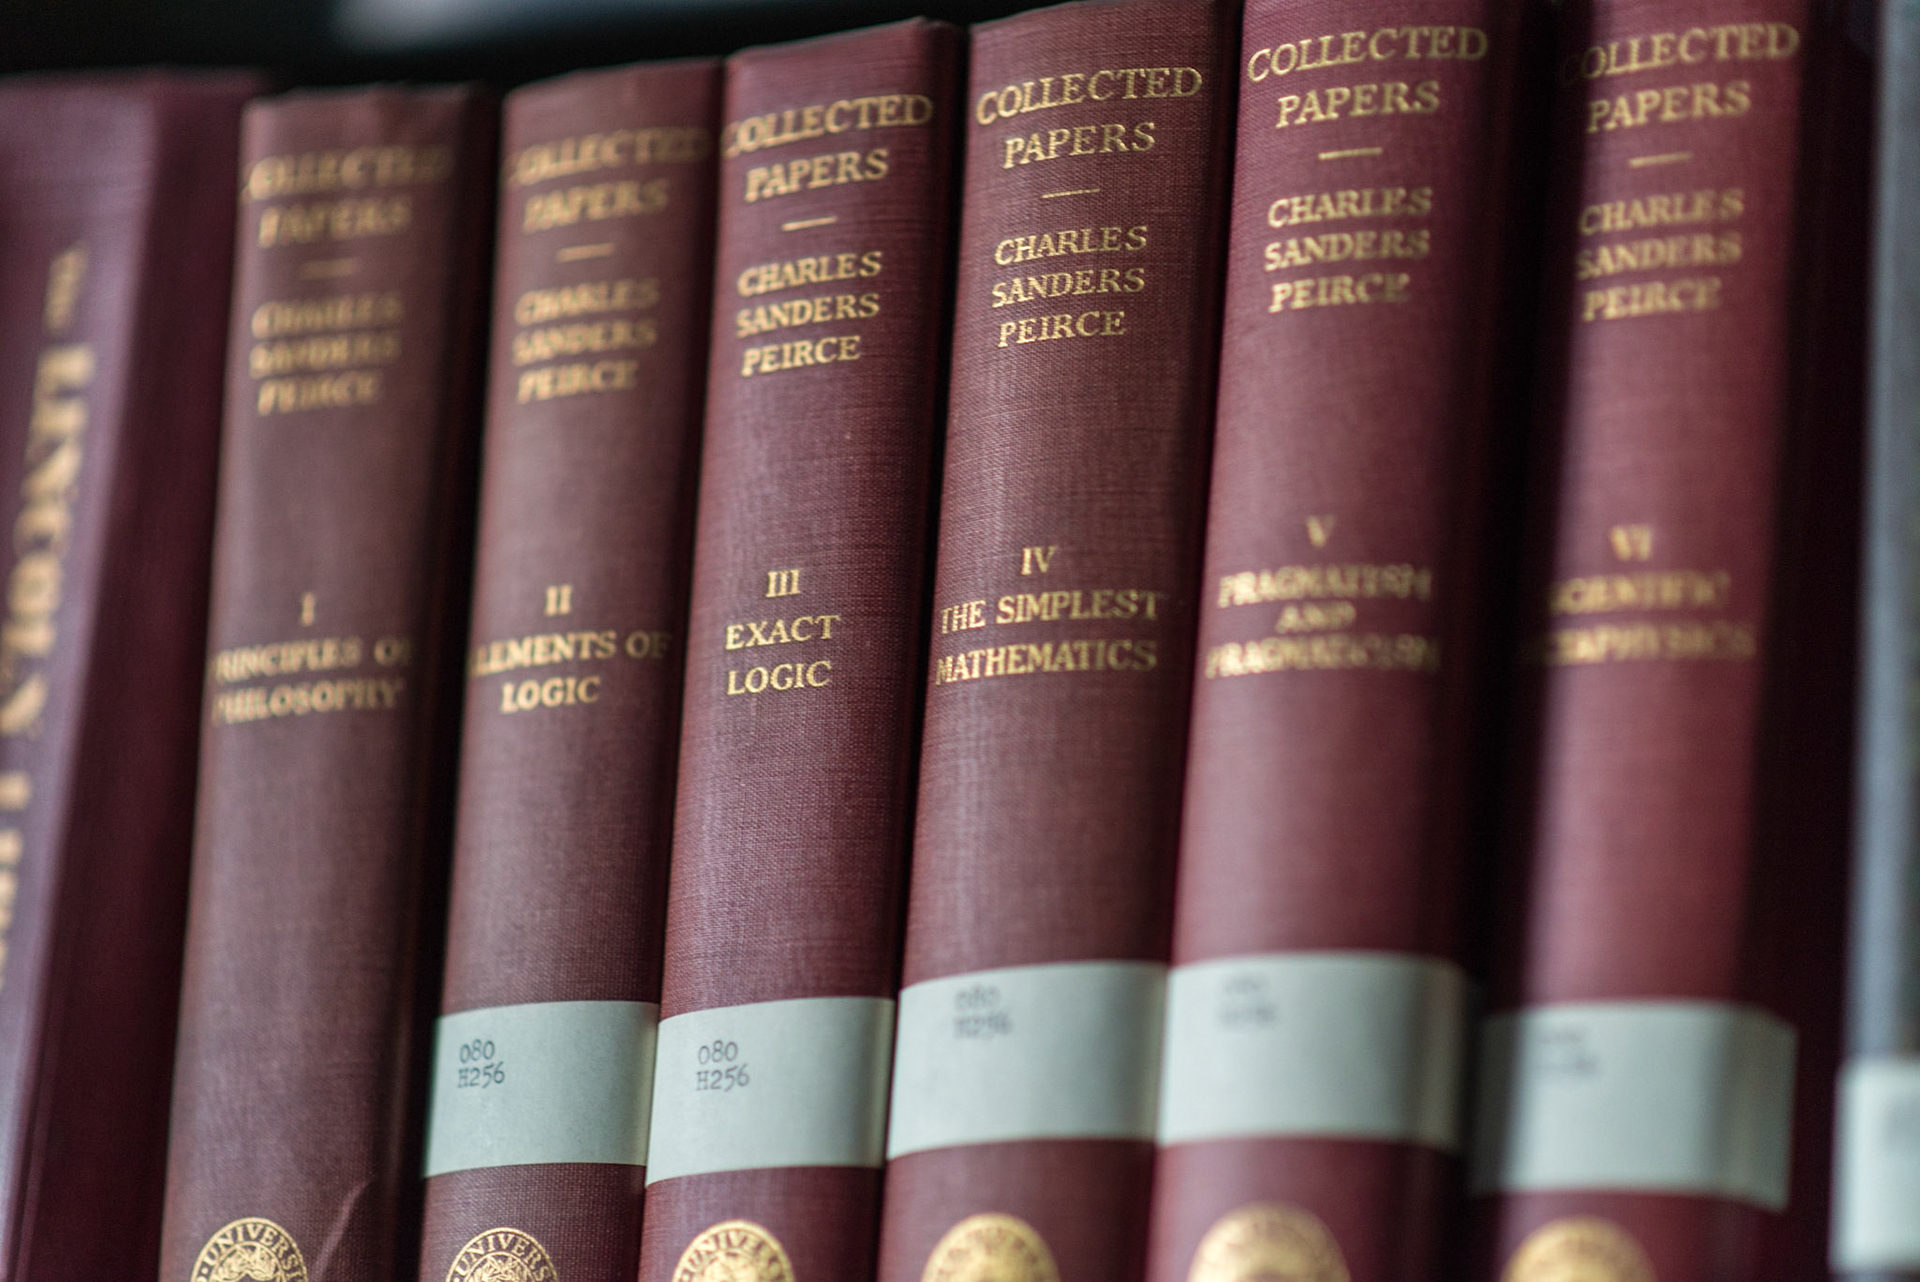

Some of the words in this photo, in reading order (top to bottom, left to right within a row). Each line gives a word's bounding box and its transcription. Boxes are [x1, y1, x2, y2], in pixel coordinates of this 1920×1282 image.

[1246, 26, 1489, 83] COLLECTED
[975, 66, 1203, 127] COLLECTED
[1274, 80, 1441, 129] PAPERS
[1586, 80, 1752, 134] PAPERS
[720, 94, 934, 161] COLLECTED
[1002, 120, 1157, 171] PAPERS
[744, 148, 889, 203] PAPERS
[1267, 186, 1434, 229] CHARLES
[1578, 188, 1744, 236] CHARLES
[994, 225, 1148, 267] CHARLES
[1264, 229, 1431, 273] SANDERS
[1575, 231, 1743, 281] SANDERS
[736, 250, 882, 298] CHARLES
[991, 267, 1146, 309] SANDERS
[1268, 272, 1412, 315] PEIRCE
[735, 292, 880, 339] SANDERS
[1583, 275, 1722, 323] PEIRCE
[997, 309, 1126, 350] PEIRCE
[740, 334, 862, 379] PEIRCE
[764, 567, 802, 599] III
[1019, 545, 1058, 577] IV
[545, 583, 573, 618] II
[941, 598, 987, 635] THE
[995, 588, 1166, 625] SIMPLEST
[724, 613, 841, 651] EXACT
[726, 659, 832, 696] LOGIC
[934, 638, 1158, 686] MATHEMATICS
[501, 674, 601, 714] LOGIC
[458, 1038, 496, 1064] 080
[697, 1038, 739, 1066] 080
[456, 1061, 507, 1089] H256
[695, 1063, 751, 1092] H256
